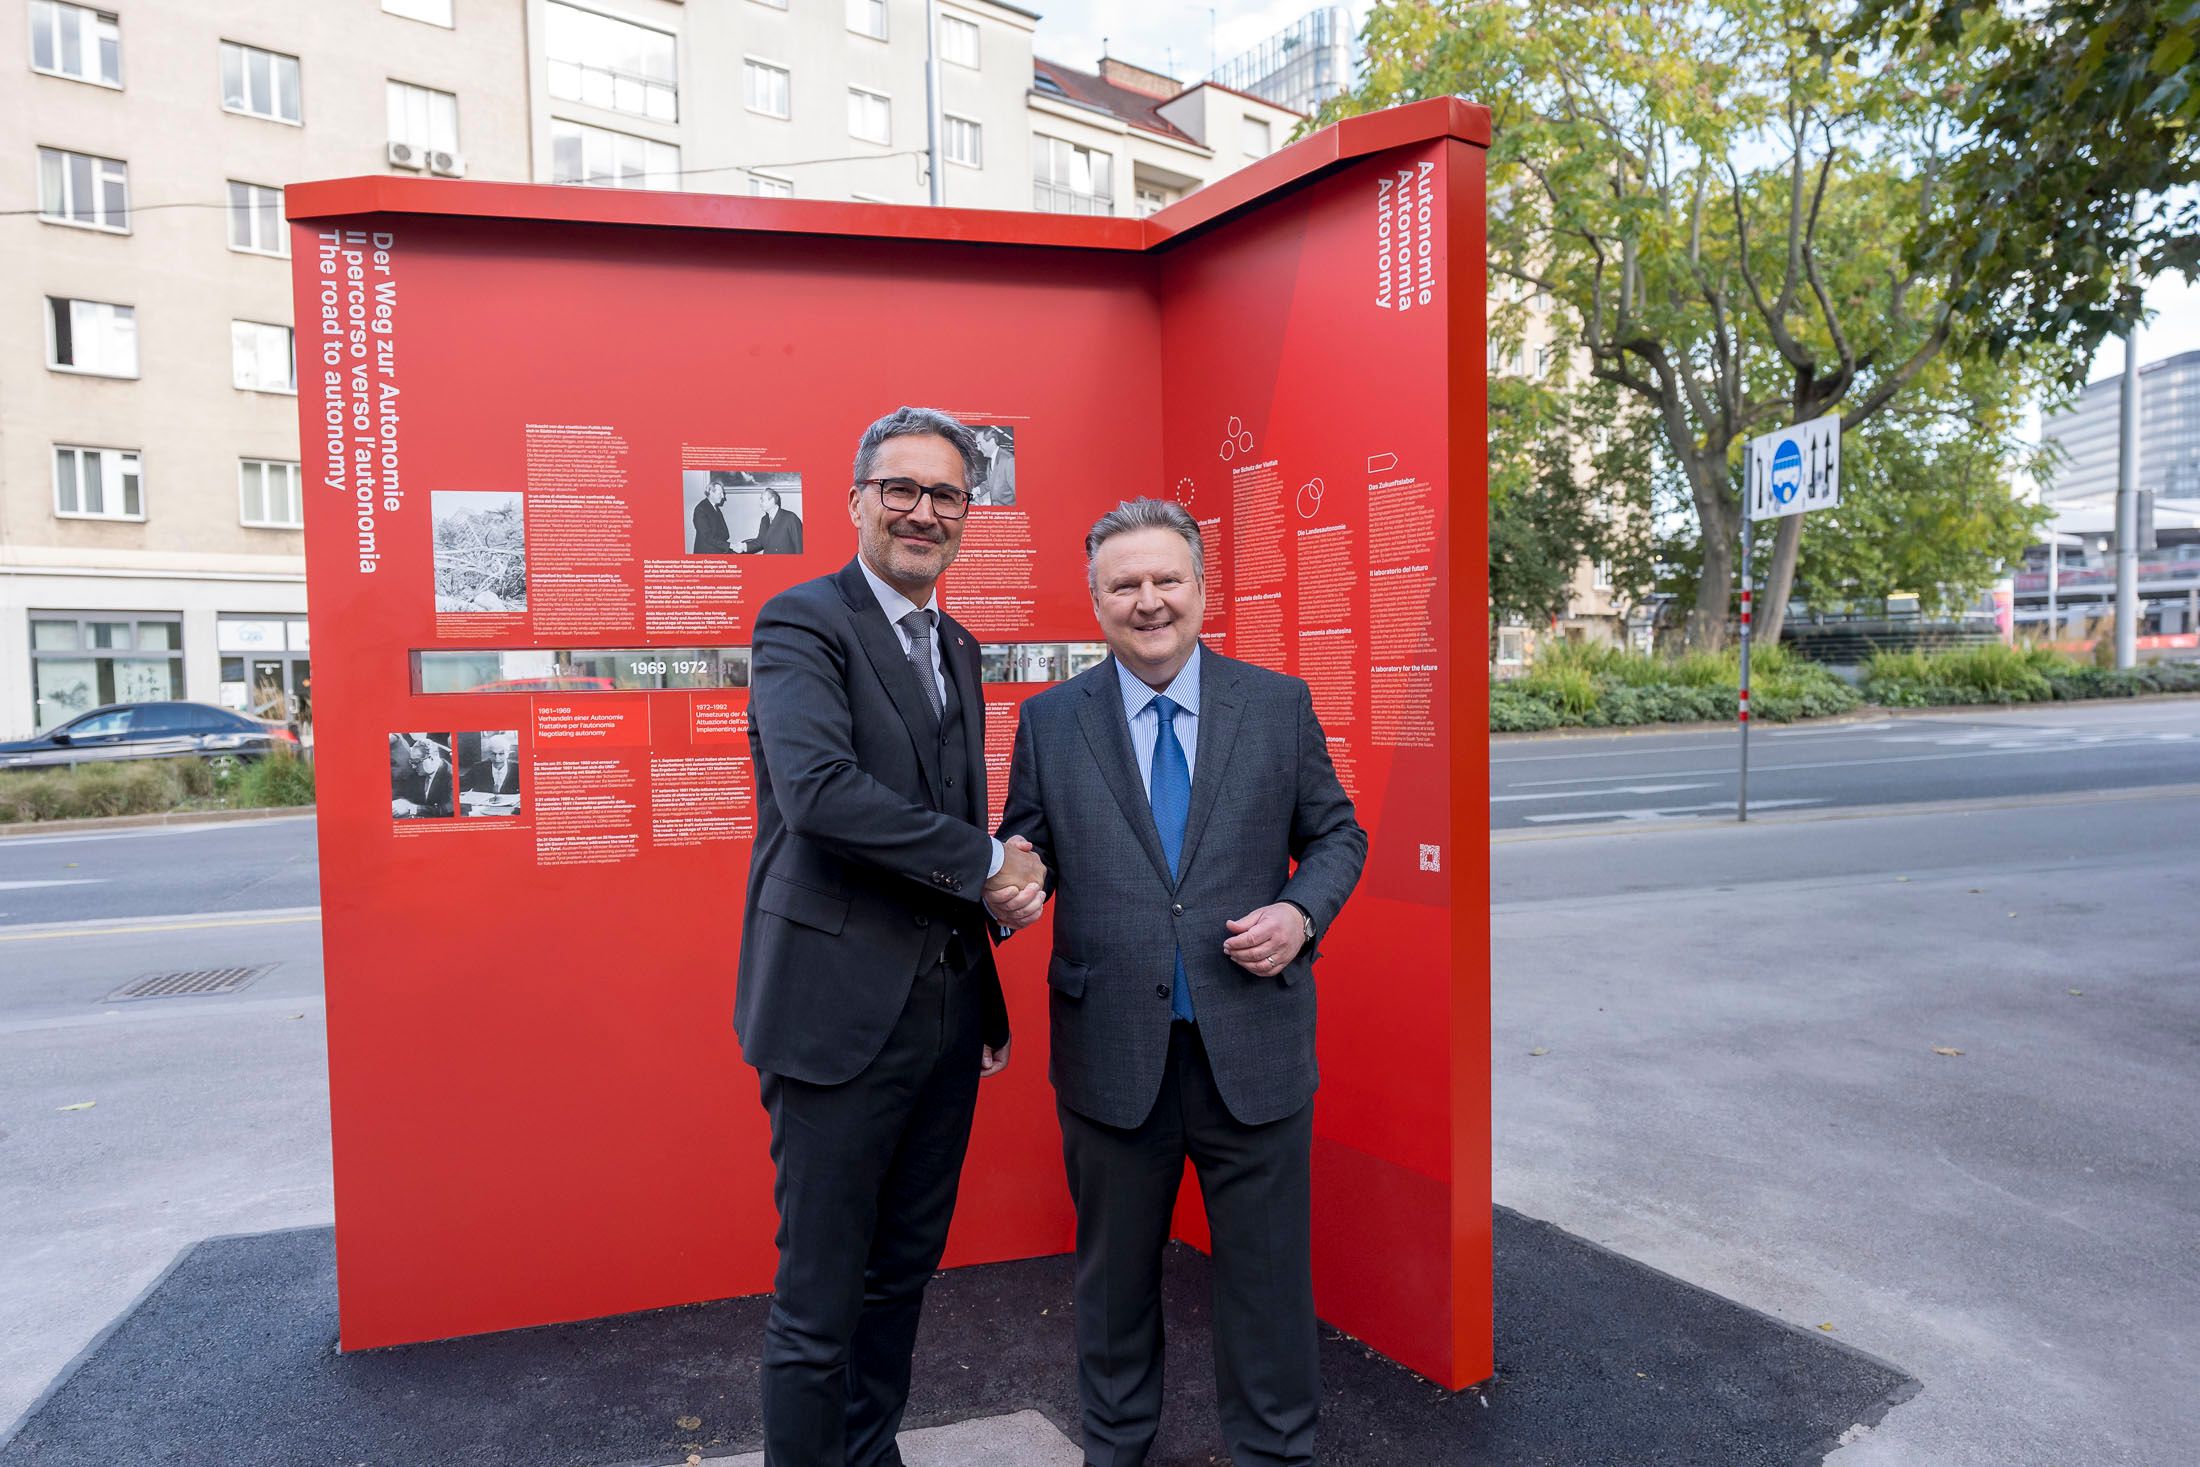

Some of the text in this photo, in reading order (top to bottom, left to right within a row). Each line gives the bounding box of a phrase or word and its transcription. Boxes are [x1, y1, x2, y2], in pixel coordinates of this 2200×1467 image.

[346, 232, 367, 243] Il
[1376, 179, 1393, 309] Autonomy
[1397, 170, 1414, 311] Autonomia
[1418, 161, 1435, 305] Autonomie
[341, 250, 367, 358] percorso
[319, 229, 346, 491] The road to autonomy
[371, 232, 404, 512] Der Weg zur Autonomie
[352, 363, 370, 430] verso
[1379, 477, 1415, 488] Zukunftslabor
[1306, 524, 1346, 535] Landesautonomie
[1374, 568, 1401, 576] laboratorio
[631, 661, 708, 674] 1969 1972
[575, 730, 606, 738] autonomy
